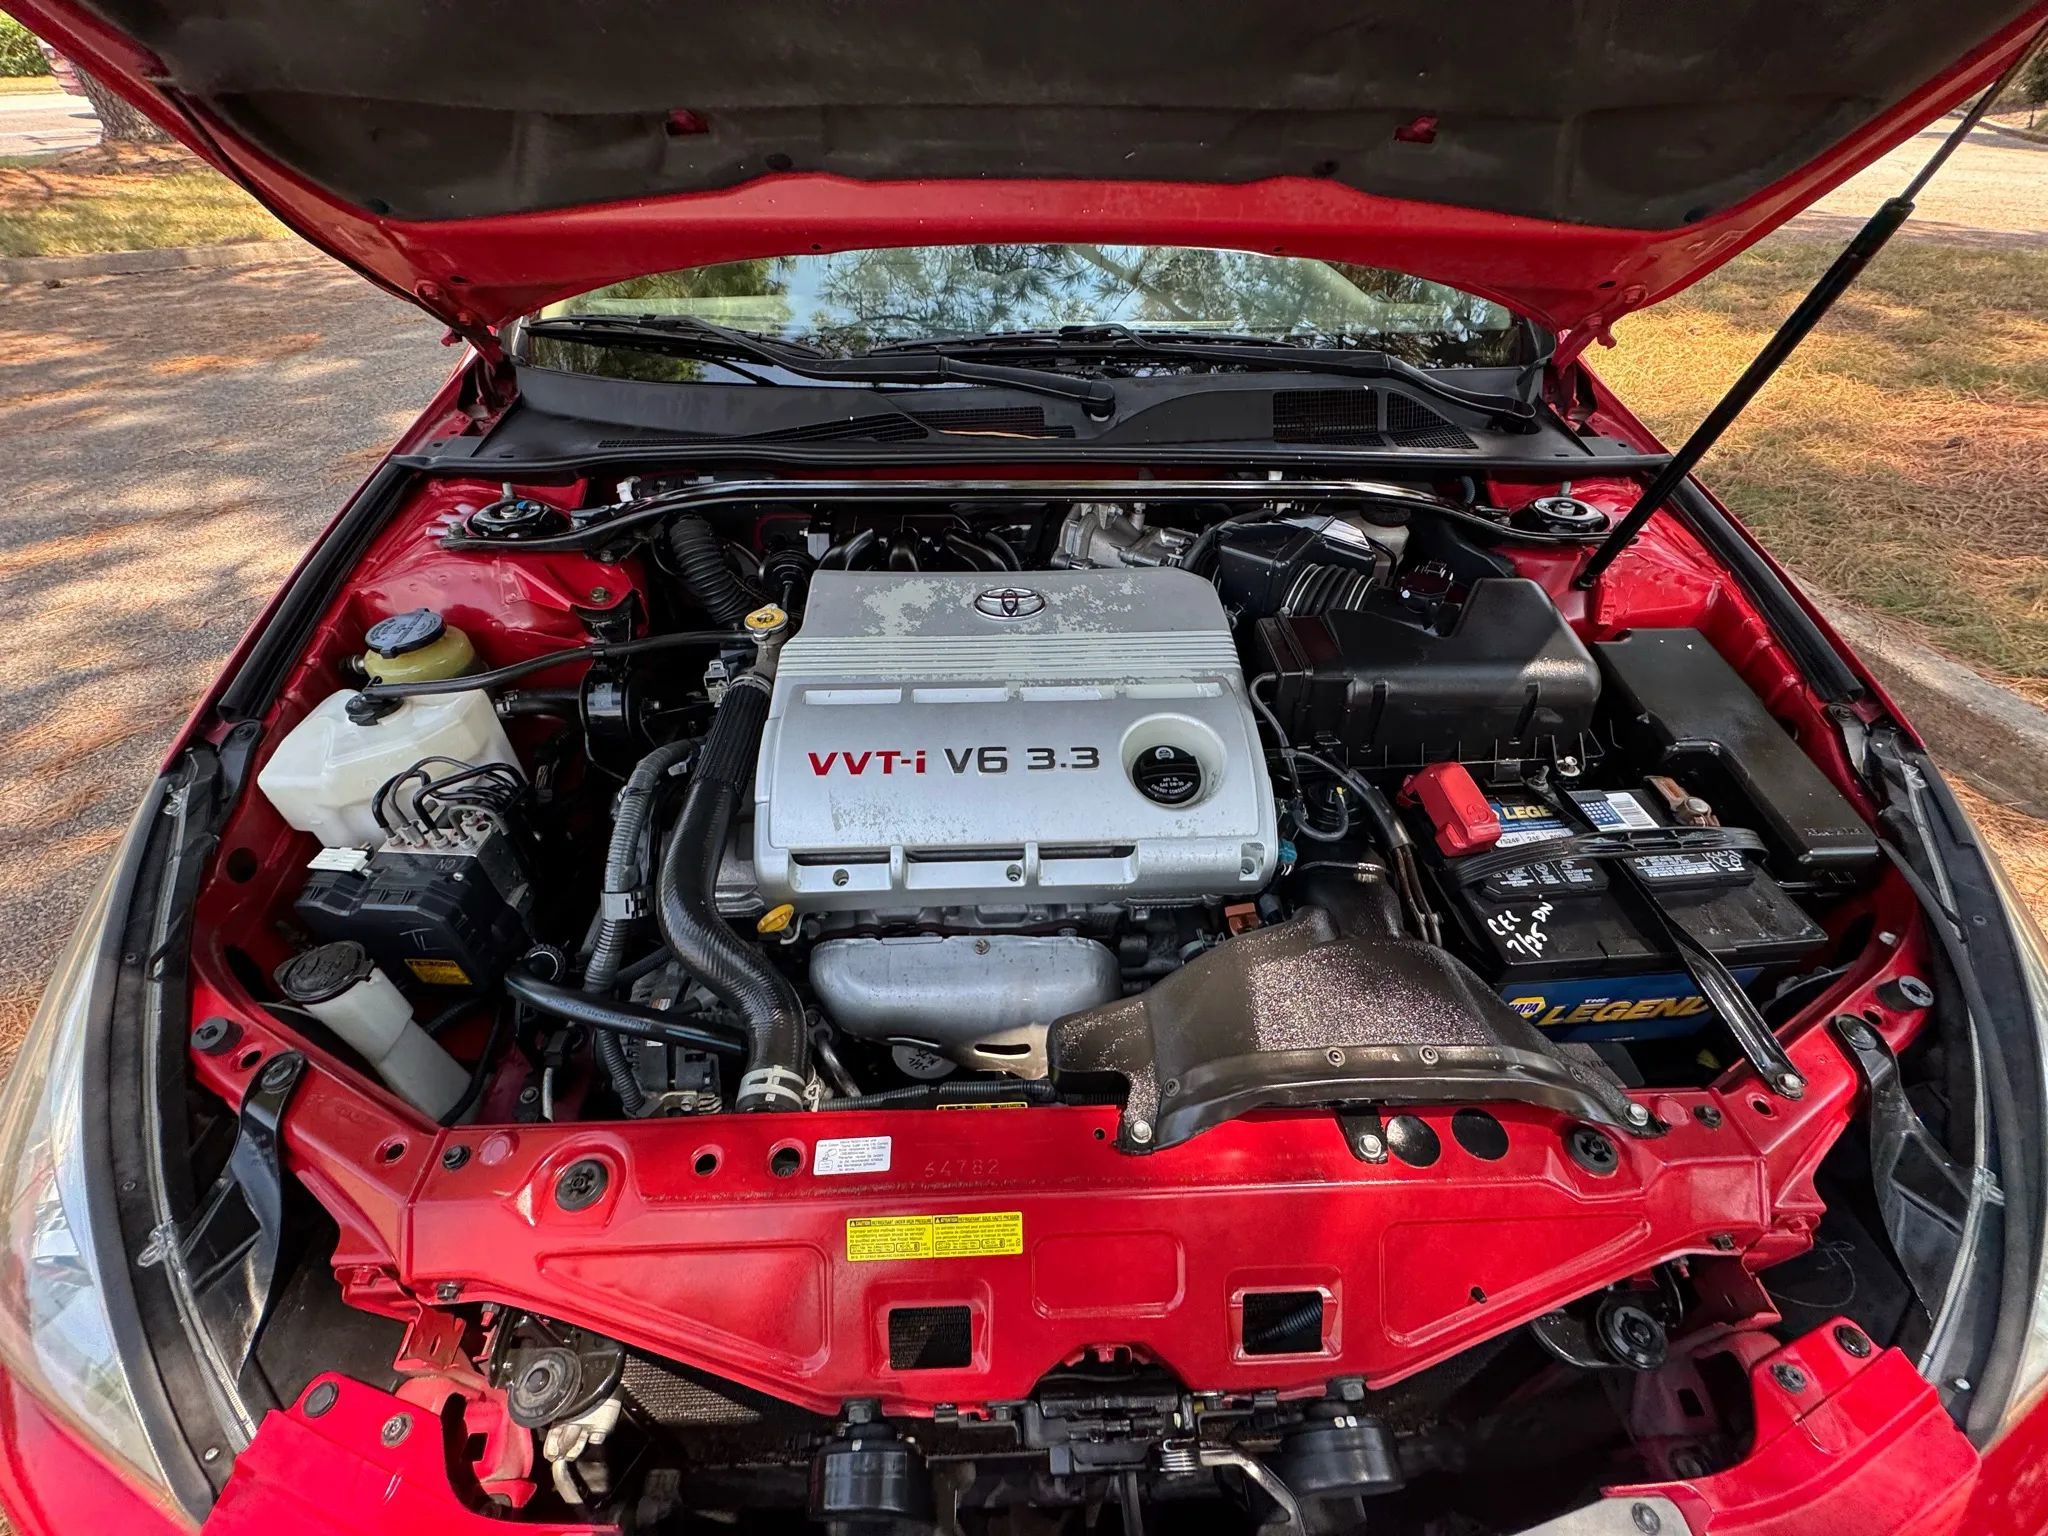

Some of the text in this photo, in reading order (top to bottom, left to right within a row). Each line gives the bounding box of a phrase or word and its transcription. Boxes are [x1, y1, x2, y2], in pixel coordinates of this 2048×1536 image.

[808, 746, 1100, 776] VVT-i V6 3.3
[1151, 781, 1193, 794] ENERGY CONSERVING
[1502, 805, 1553, 819] LEGE
[1536, 996, 1710, 1026] LEGEND
